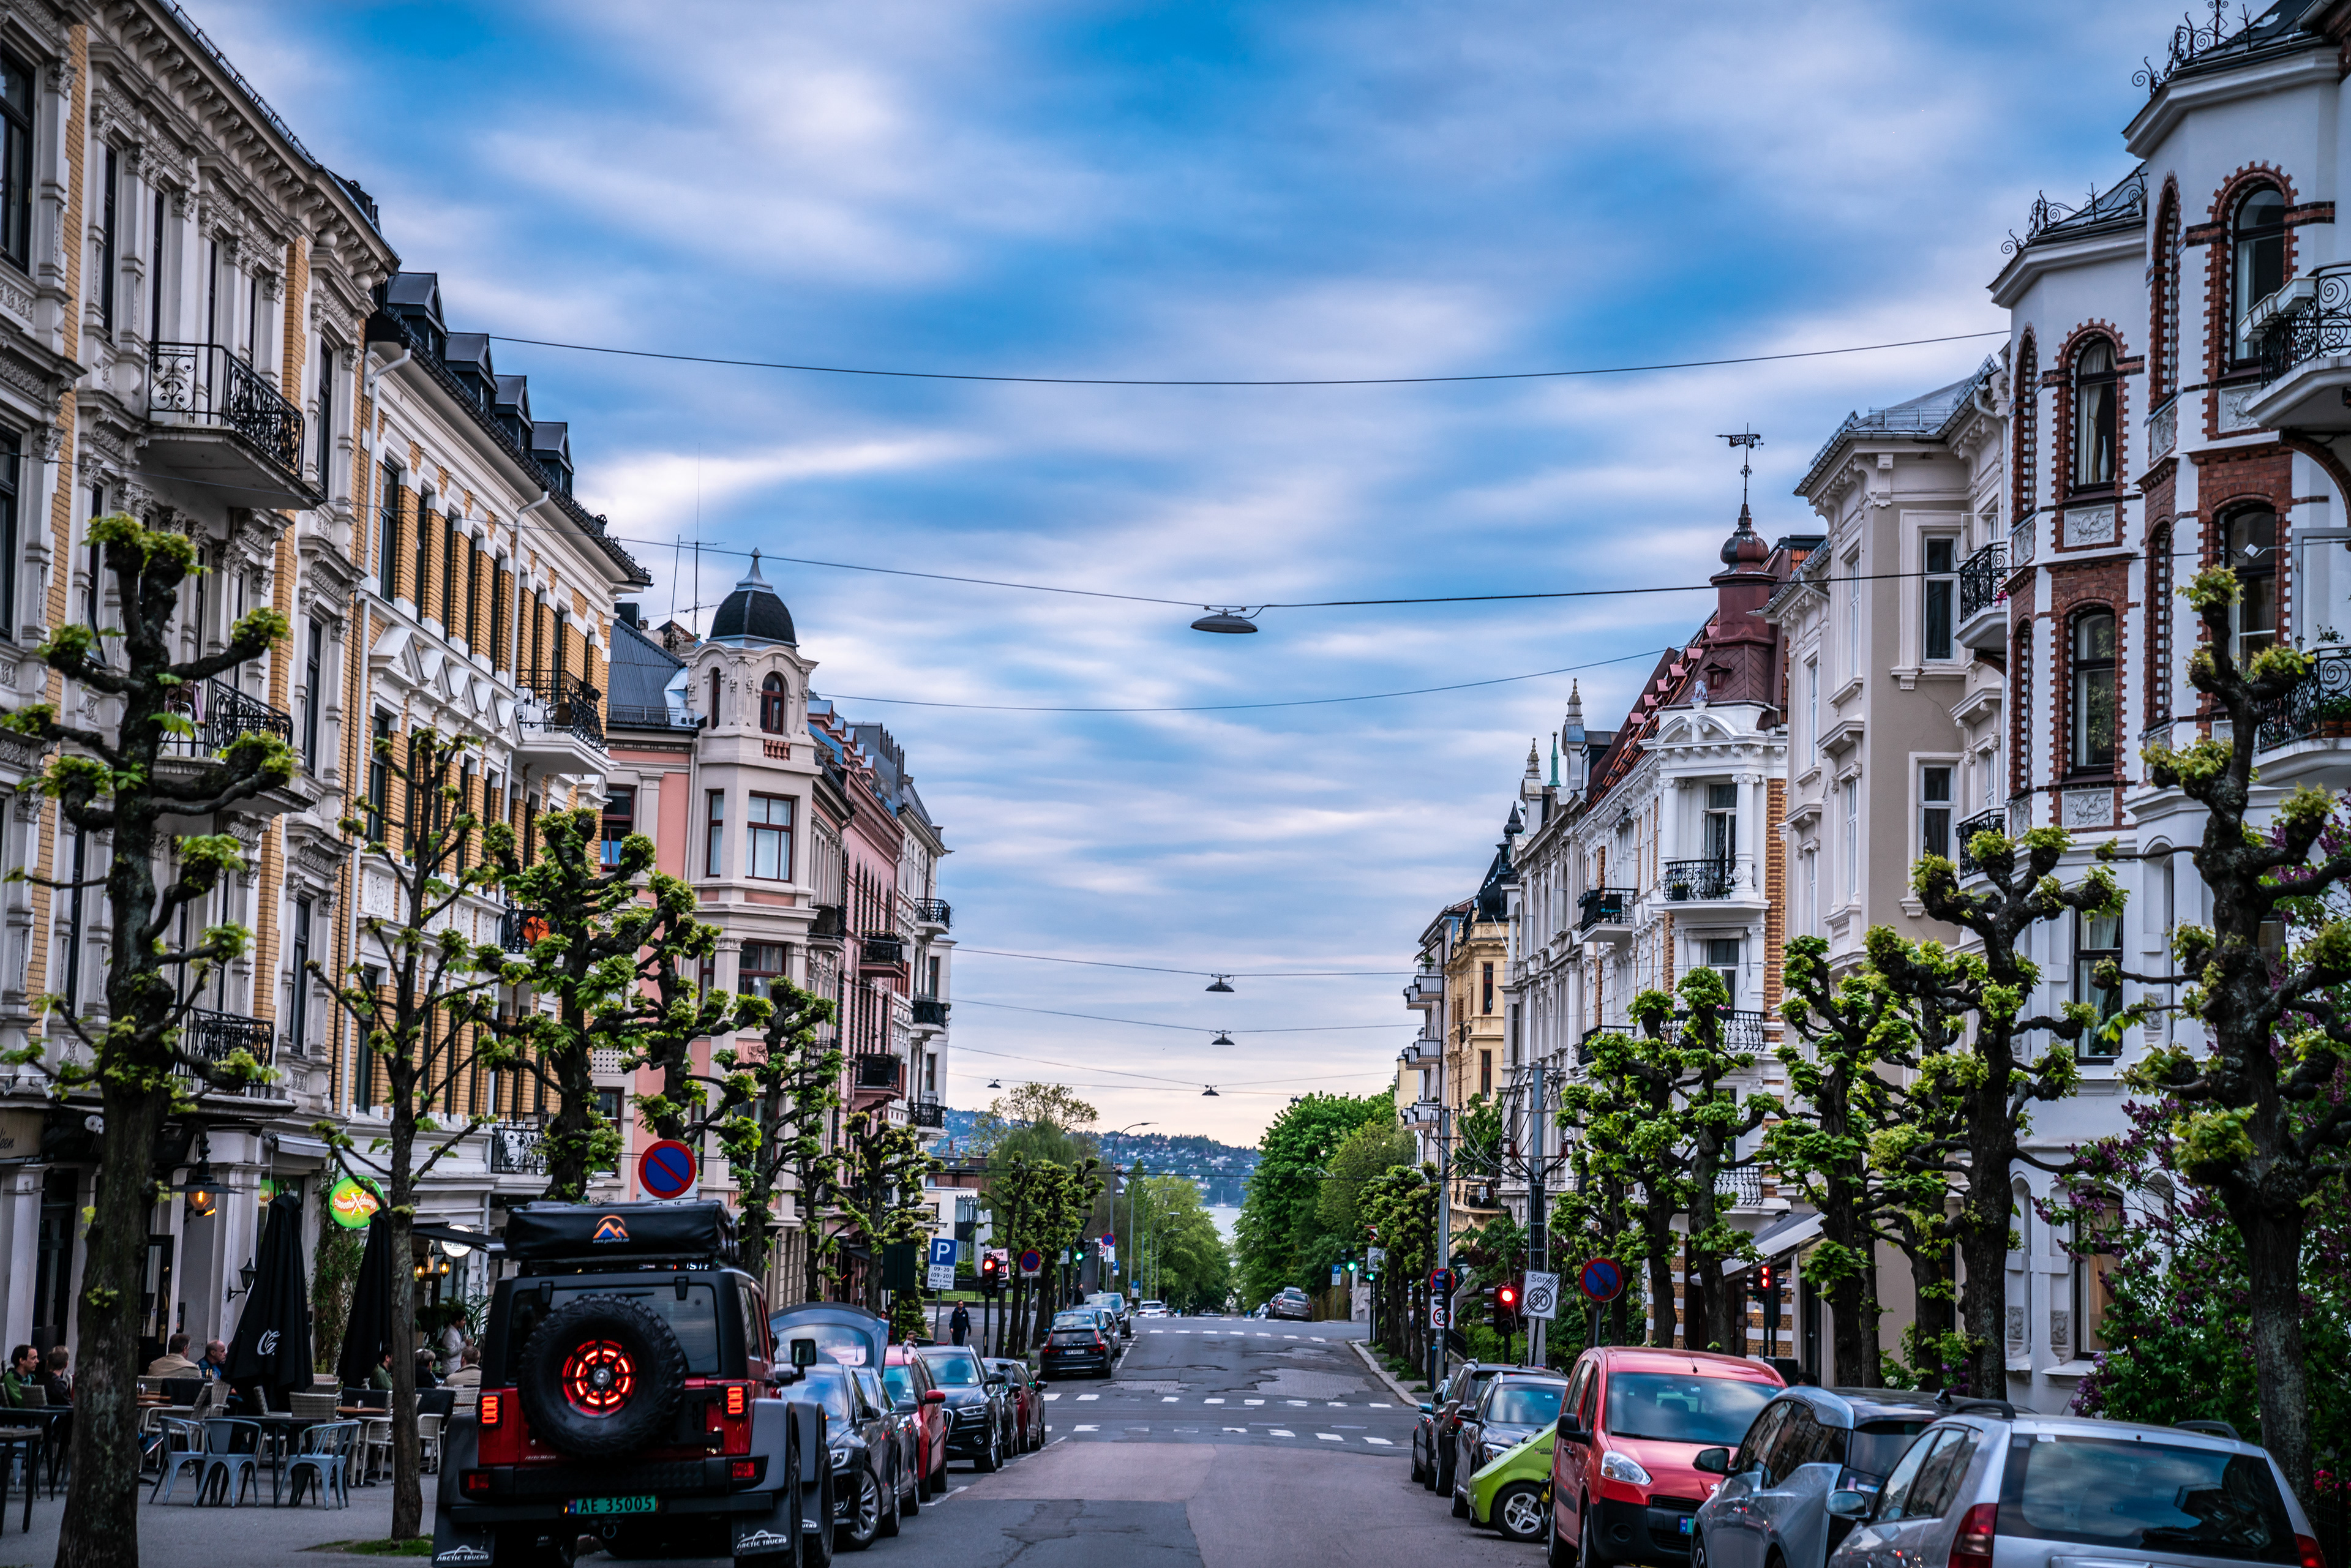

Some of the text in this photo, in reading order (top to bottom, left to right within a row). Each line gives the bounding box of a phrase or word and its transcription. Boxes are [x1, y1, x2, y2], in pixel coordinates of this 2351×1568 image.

[936, 1242, 950, 1261] P
[580, 1497, 651, 1513] AE 35005
[762, 1537, 787, 1546] TRUCKS
